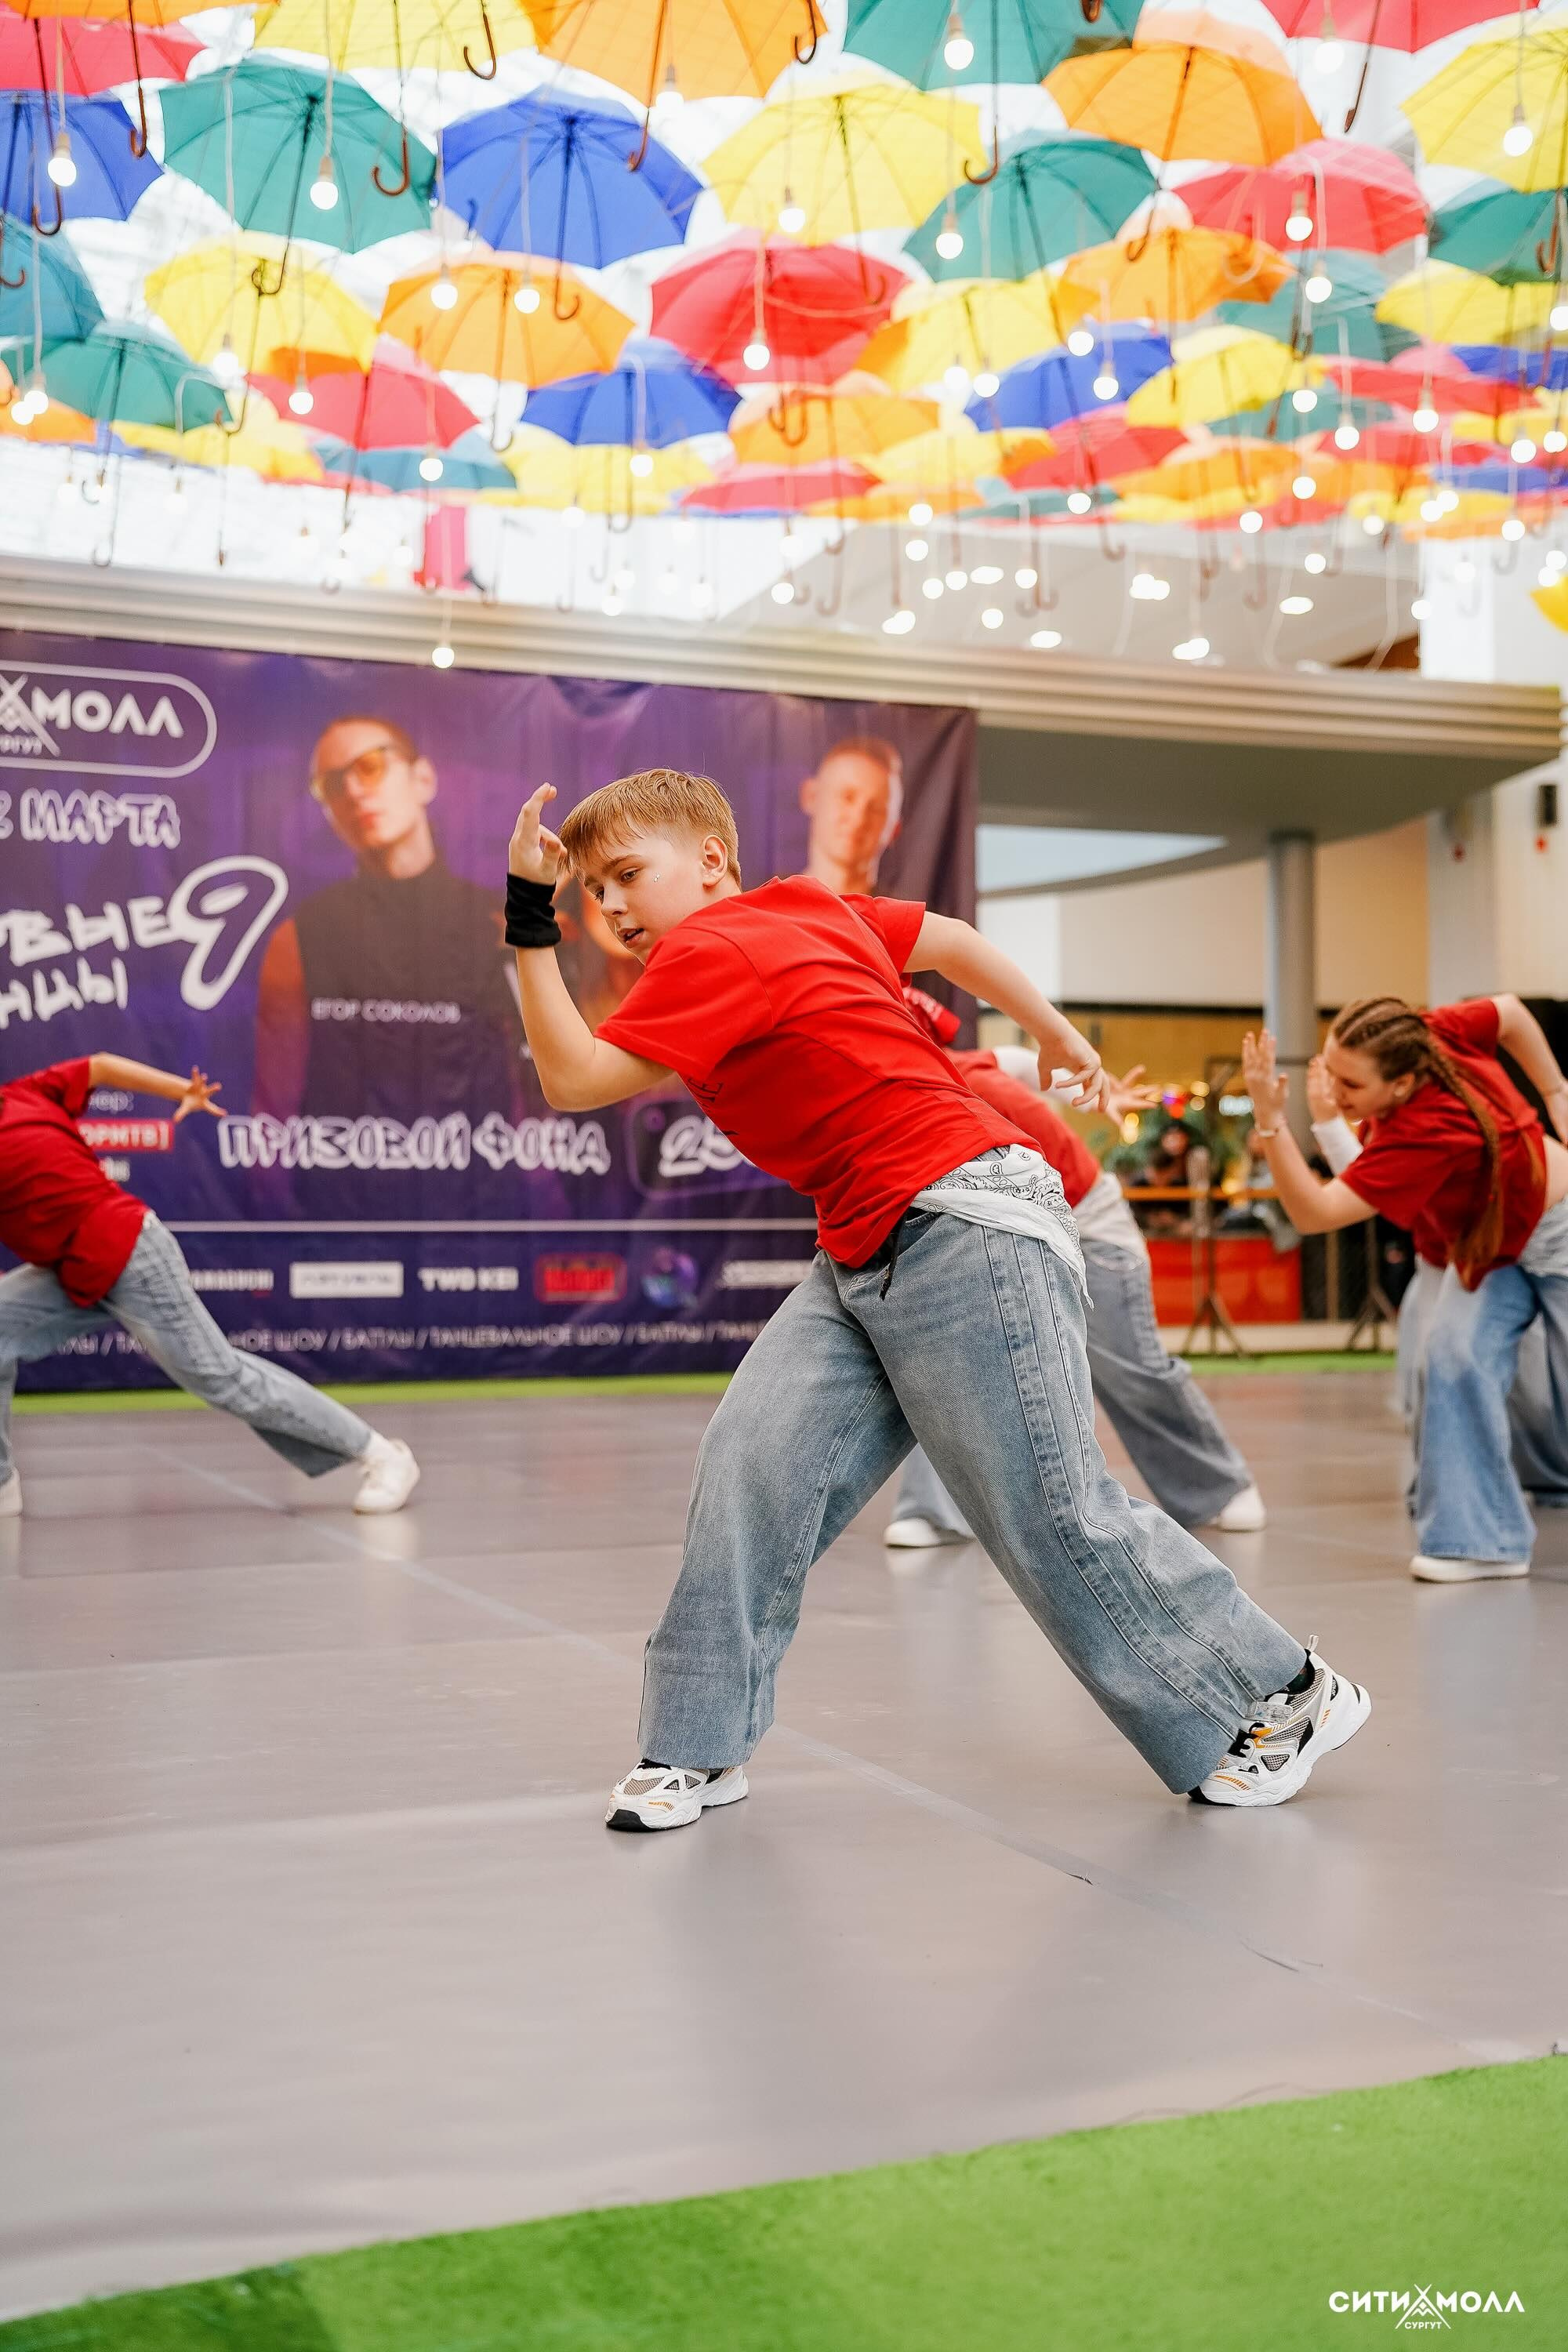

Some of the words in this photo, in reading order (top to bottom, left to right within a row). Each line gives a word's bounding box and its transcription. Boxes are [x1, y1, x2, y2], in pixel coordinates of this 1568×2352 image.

[31, 686, 184, 739] МОЛЛ
[20, 787, 181, 847] МАРТА
[0, 895, 172, 966] ВЫЕ
